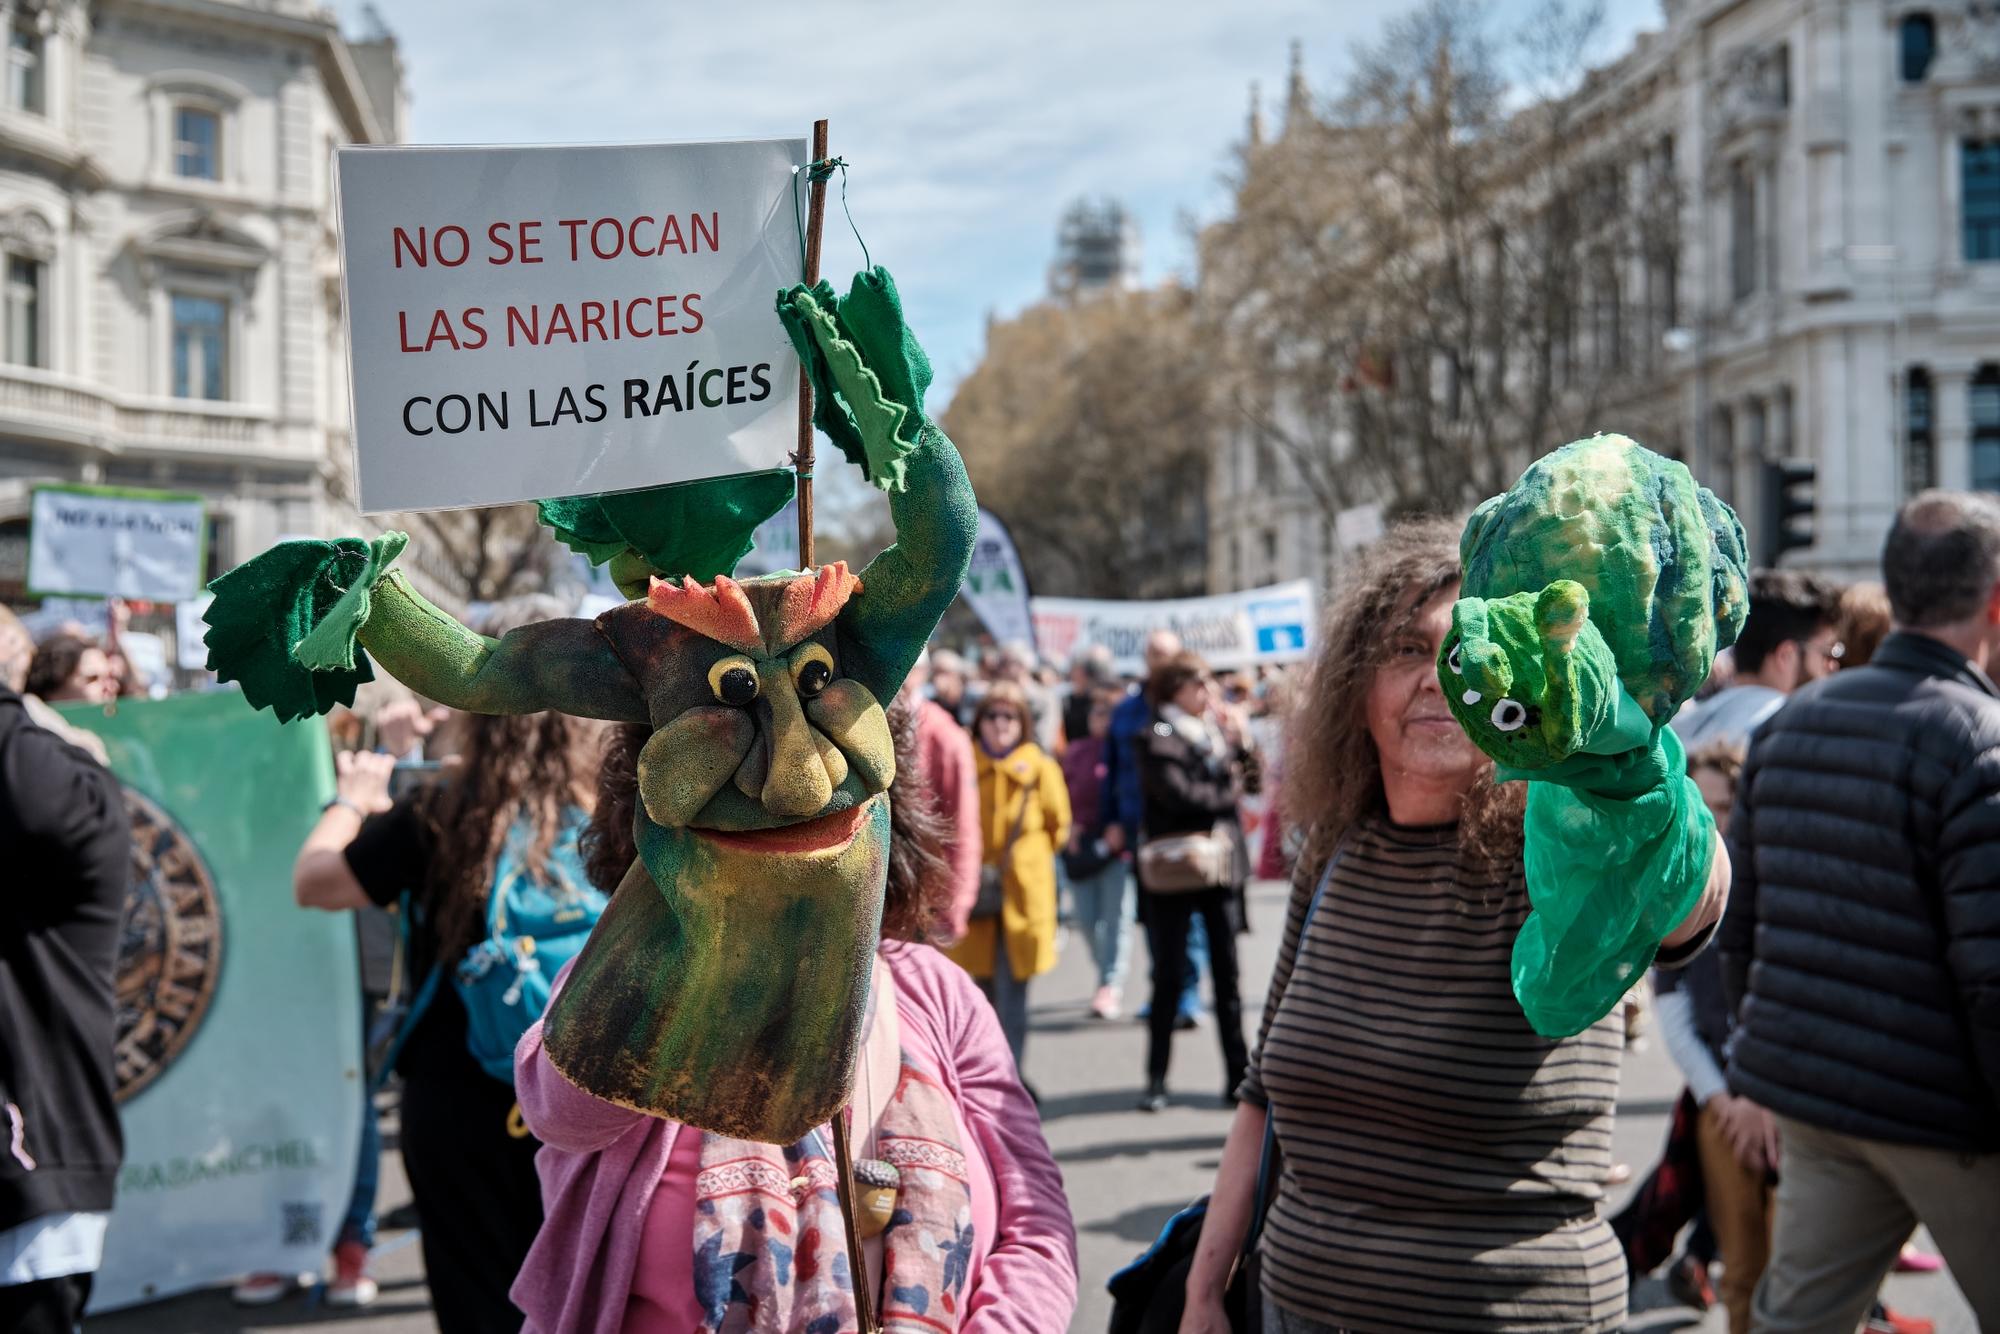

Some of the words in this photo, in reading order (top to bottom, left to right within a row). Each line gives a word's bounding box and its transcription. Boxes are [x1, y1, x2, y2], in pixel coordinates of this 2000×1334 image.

[393, 225, 470, 269] NO
[487, 221, 544, 266] SE
[558, 211, 719, 262] TOCAN
[398, 307, 489, 353] LAS
[506, 293, 704, 347] NARICES
[402, 390, 509, 437] CON
[528, 383, 608, 428] LAS
[623, 360, 772, 419] RAÍCES
